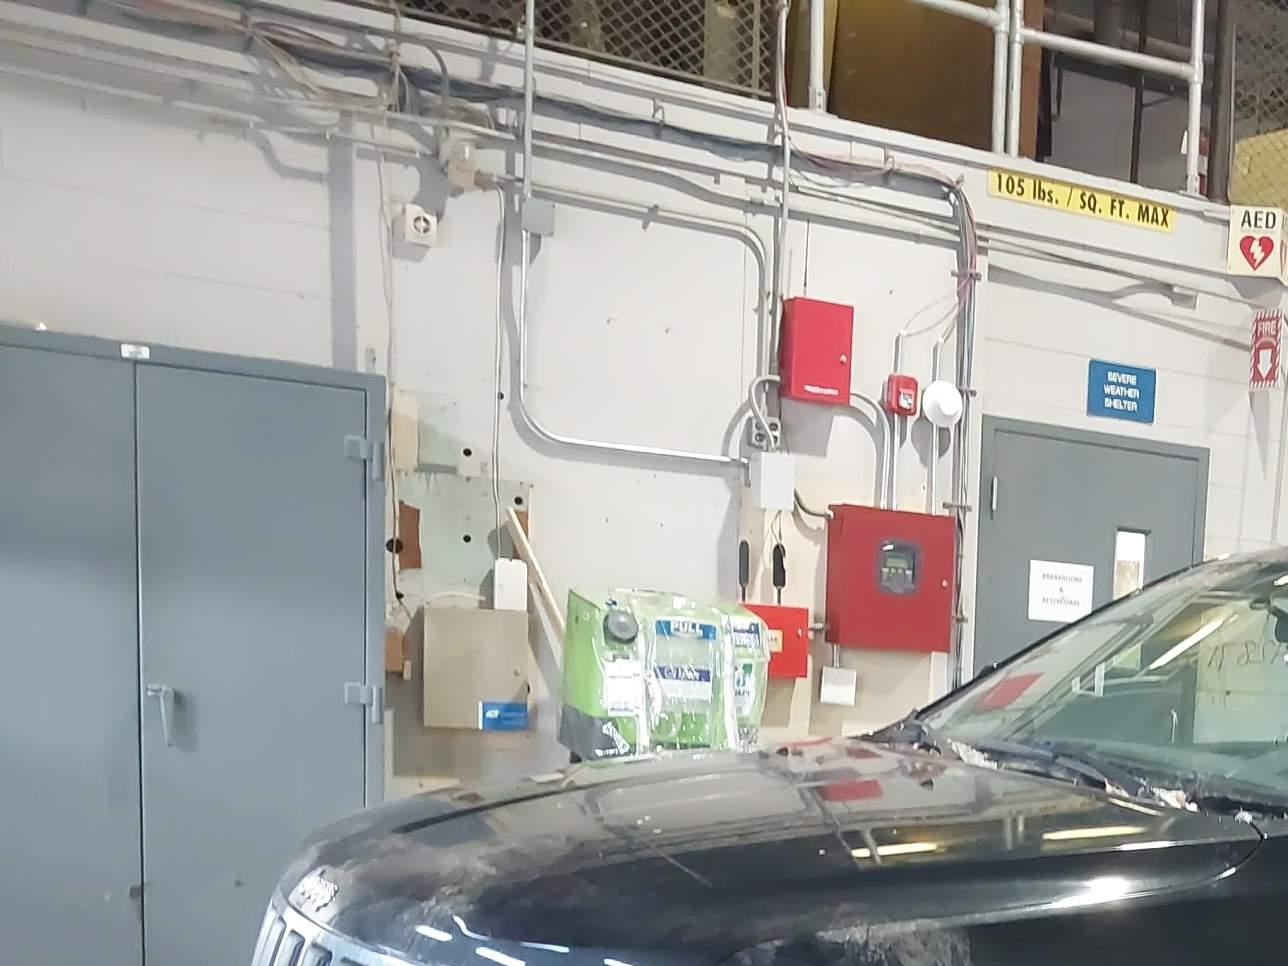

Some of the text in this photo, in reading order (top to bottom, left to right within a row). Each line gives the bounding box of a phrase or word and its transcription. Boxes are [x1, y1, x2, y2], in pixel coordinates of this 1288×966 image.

[997, 174, 1169, 228] 105 lbs. / SQ. FT. MAX
[1240, 209, 1277, 230] AED
[1257, 319, 1277, 337] FIRE
[1107, 371, 1137, 386] SEVERE
[1103, 383, 1140, 400] WEATHER
[1104, 397, 1138, 413] SHELTER
[672, 619, 704, 636] PULL
